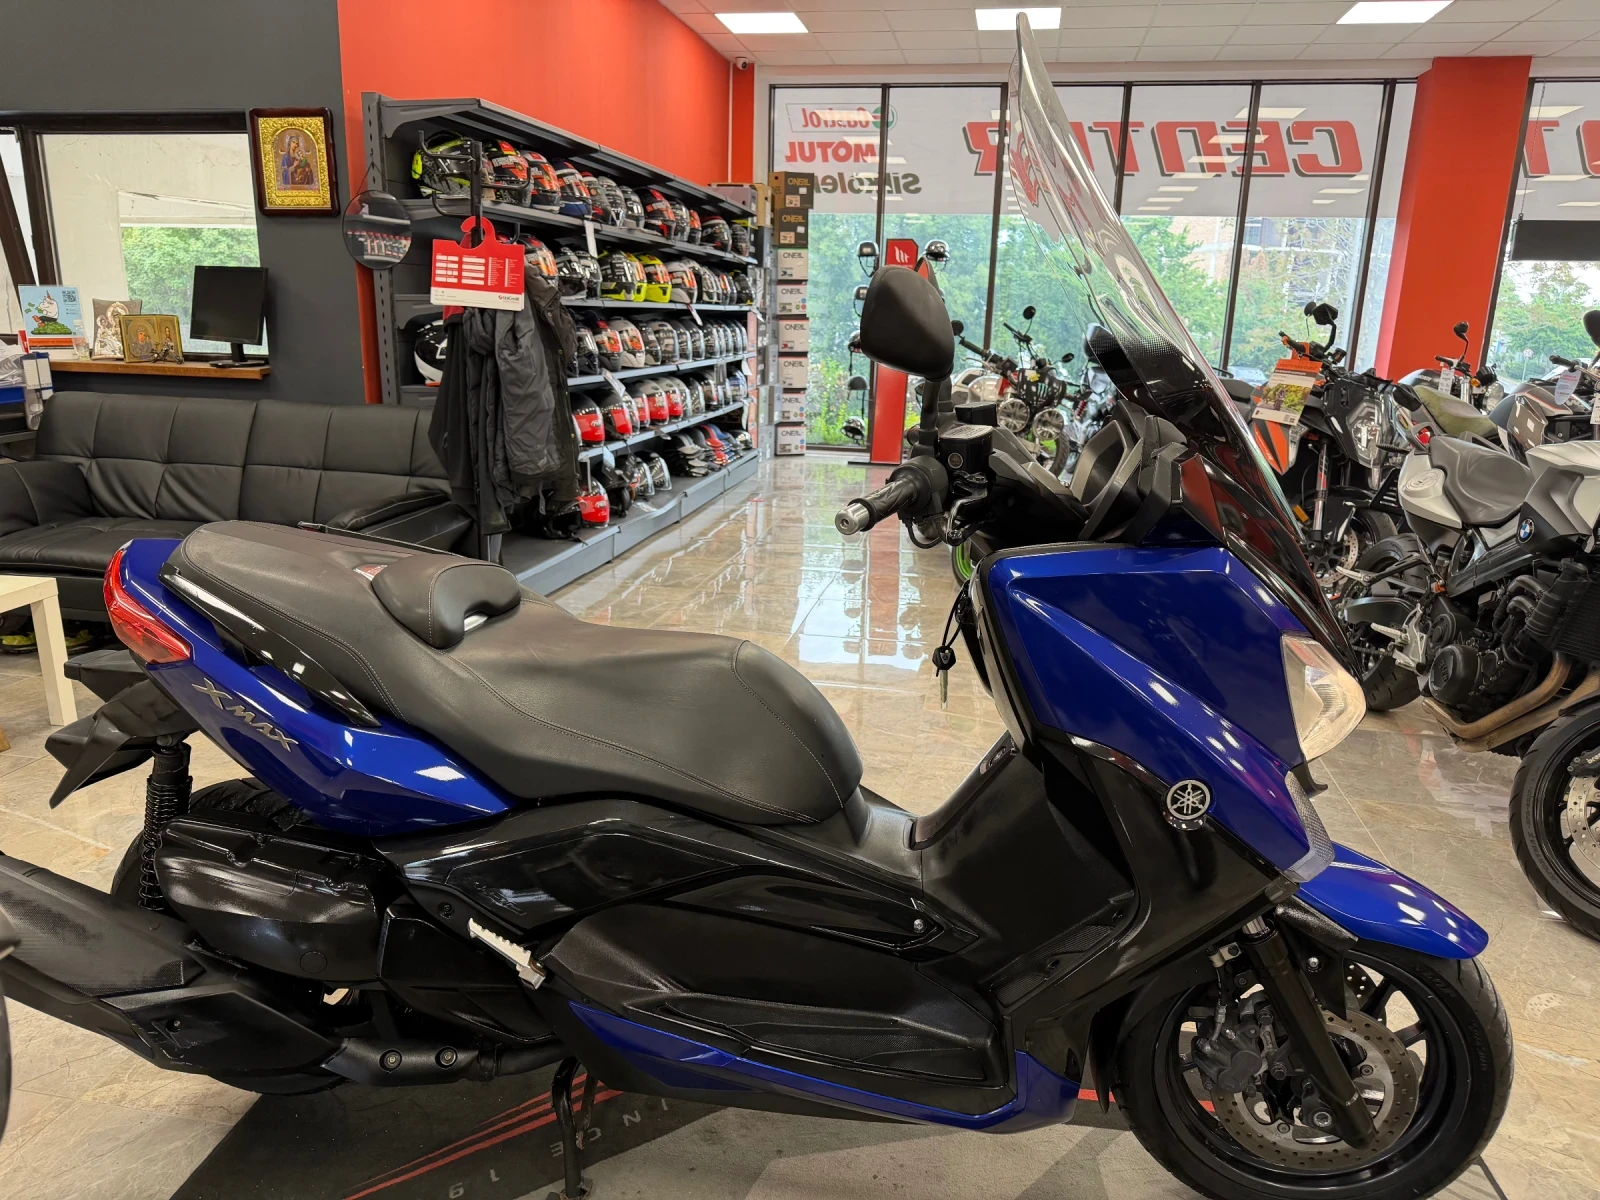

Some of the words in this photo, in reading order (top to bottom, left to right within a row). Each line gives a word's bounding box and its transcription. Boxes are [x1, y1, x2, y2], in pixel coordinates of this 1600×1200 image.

[1586, 752, 1600, 764] bre
[550, 1098, 669, 1158] INCE
[448, 1168, 500, 1199] 19
